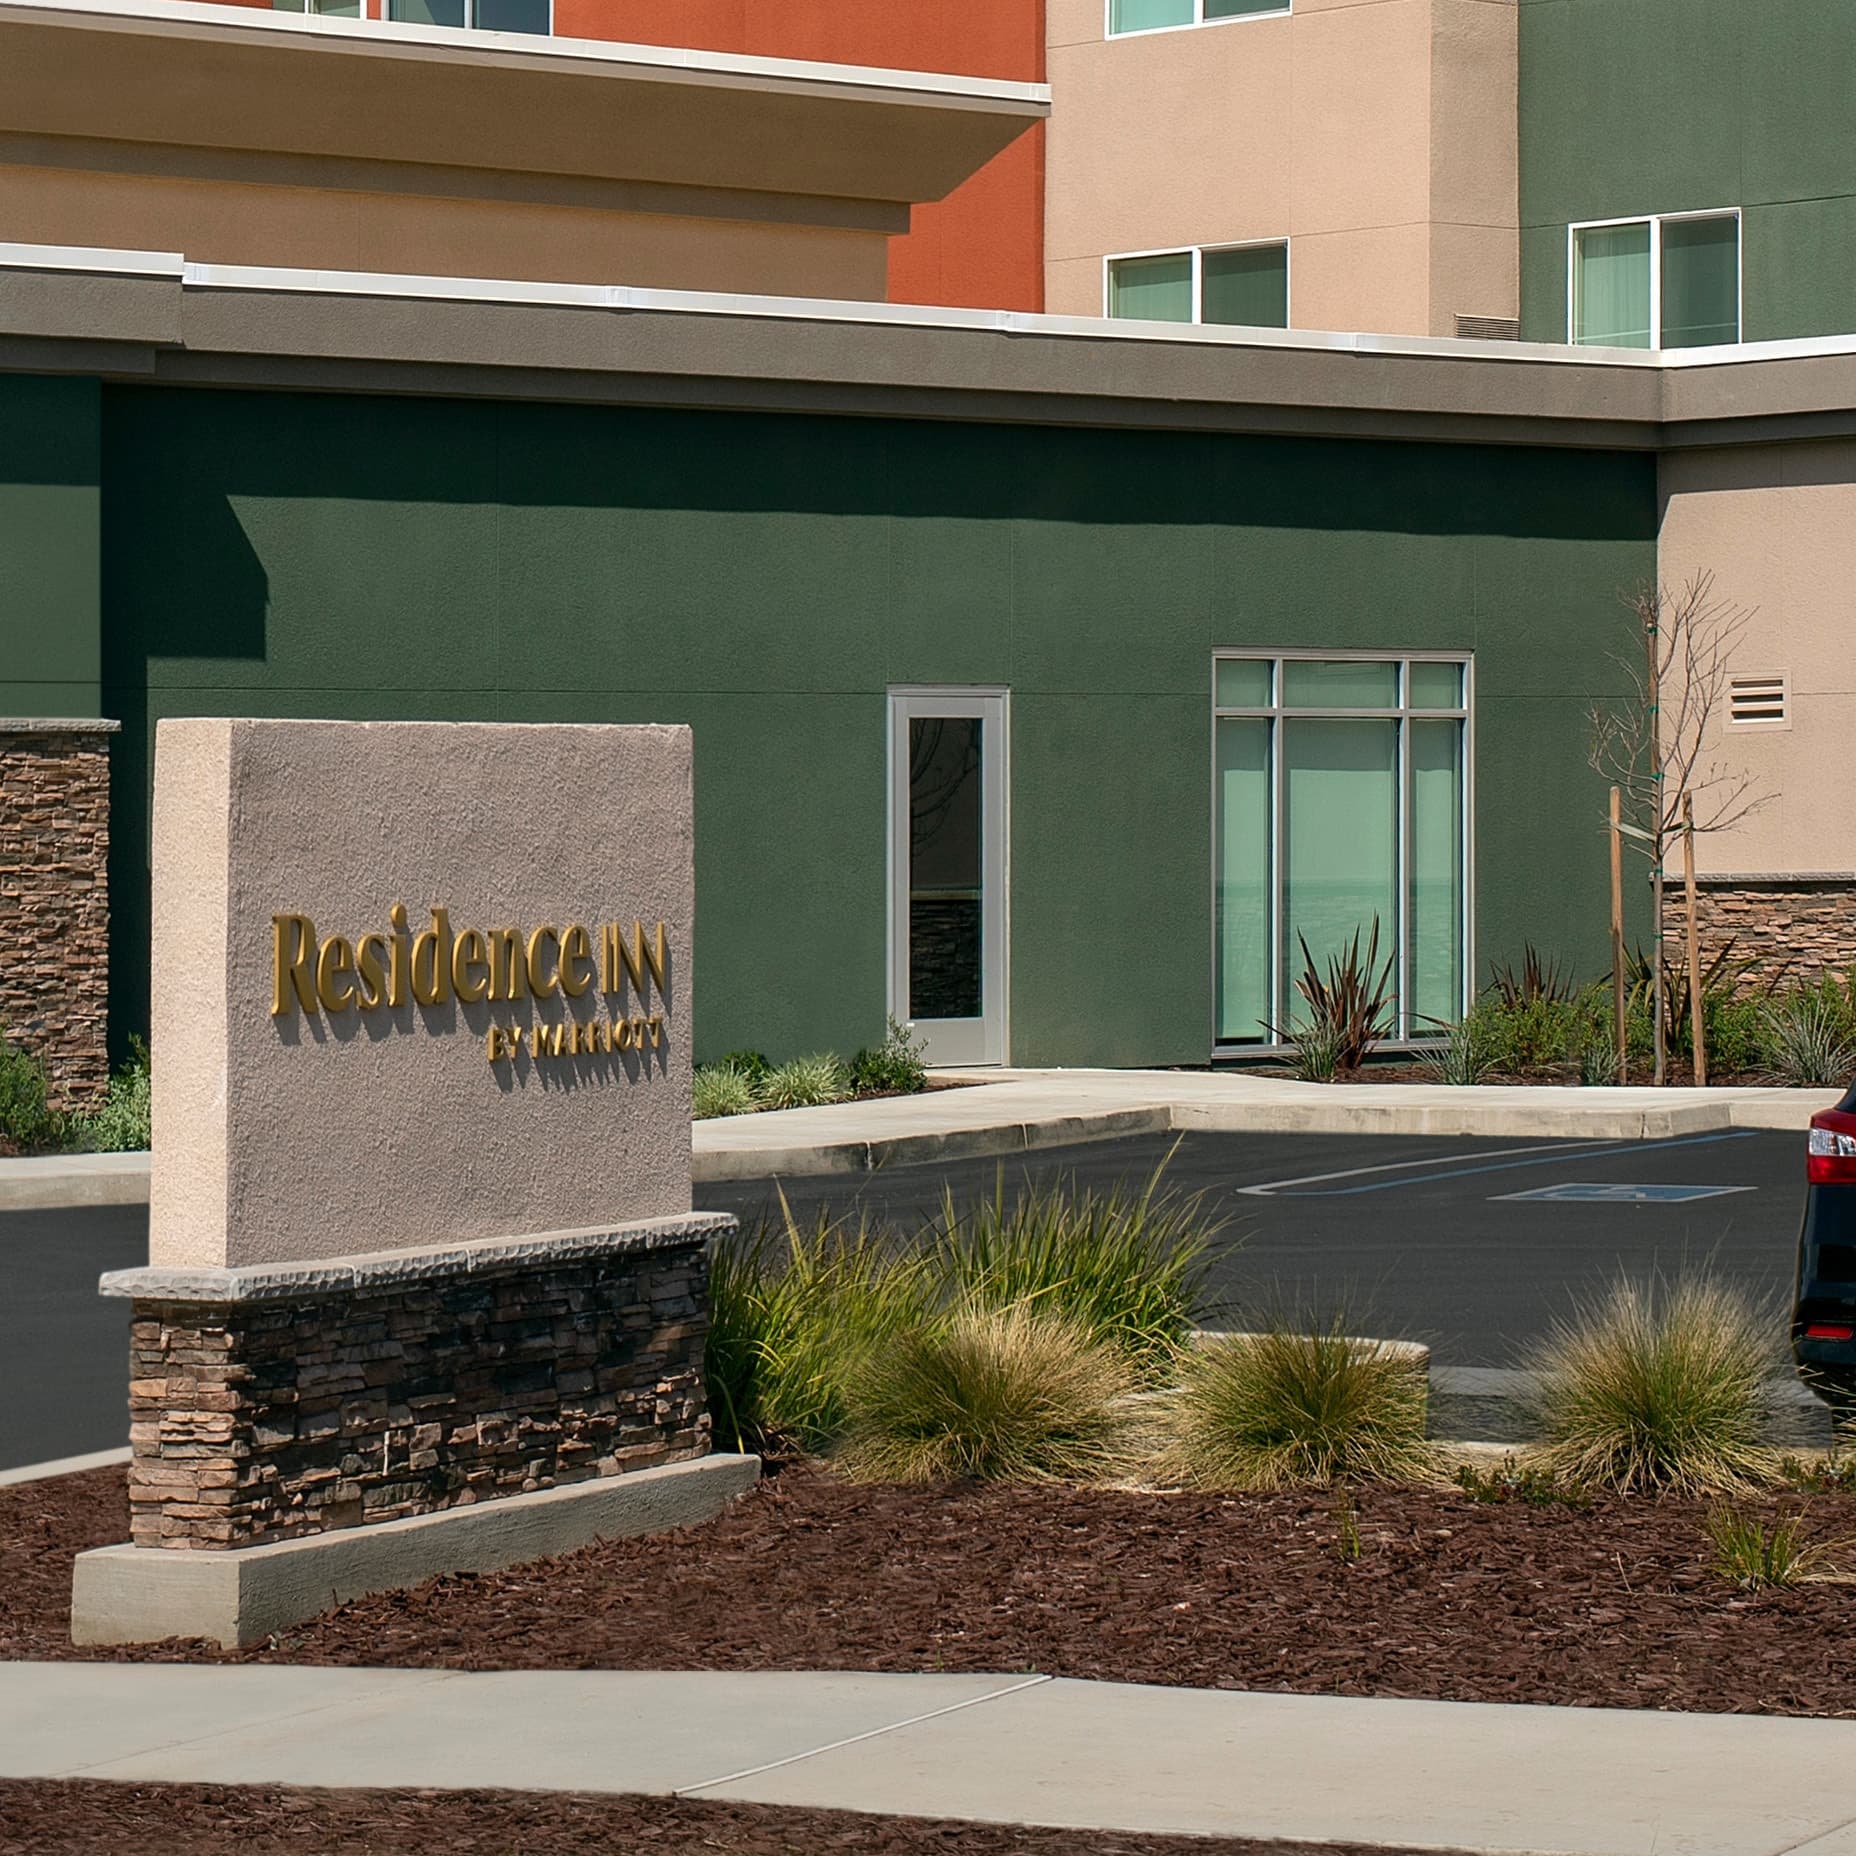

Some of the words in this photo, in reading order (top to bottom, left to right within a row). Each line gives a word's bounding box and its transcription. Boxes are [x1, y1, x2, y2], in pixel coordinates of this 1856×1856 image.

[271, 902, 591, 1016] Residence
[600, 920, 666, 995] INN
[487, 1025, 523, 1061] BY
[531, 1016, 663, 1059] MARRIOTT
